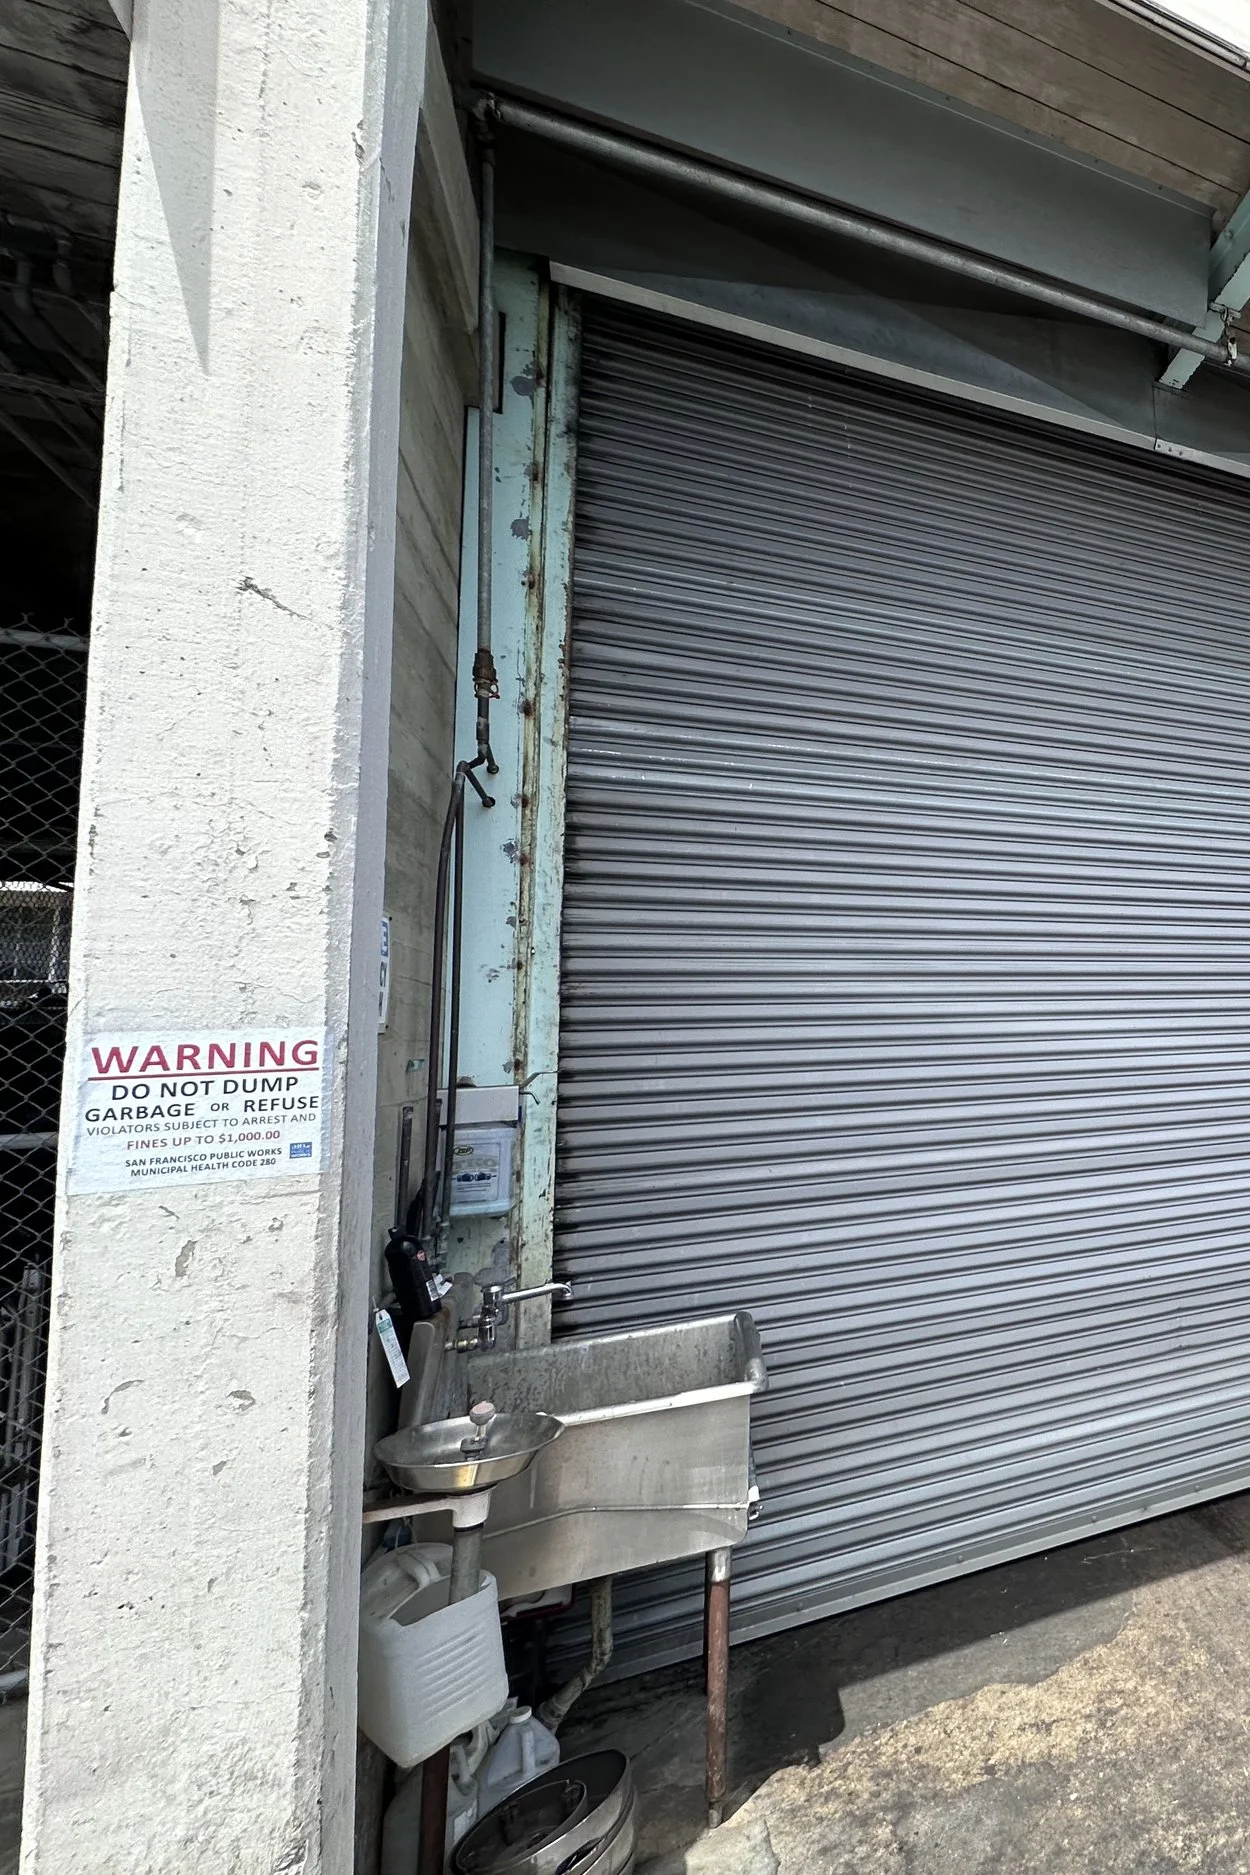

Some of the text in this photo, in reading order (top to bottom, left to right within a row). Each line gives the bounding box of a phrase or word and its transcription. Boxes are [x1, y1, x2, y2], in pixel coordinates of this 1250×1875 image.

[91, 1039, 319, 1075] WARNING
[112, 1076, 299, 1101] DO NOT DUMP
[84, 1095, 320, 1123] GARBAGE OR REFUSE
[86, 1112, 317, 1137] VIOLATORS SUBJECT TO ARREST AND
[127, 1129, 281, 1151] FINES UP TO $1,000.00
[125, 1158, 147, 1168] SAN
[149, 1153, 208, 1166] FRANCISCO
[209, 1149, 246, 1161] PUBLIC
[247, 1147, 283, 1158] WORKS
[130, 1157, 277, 1177] MUNICIPAL HEALTH CODE 280
